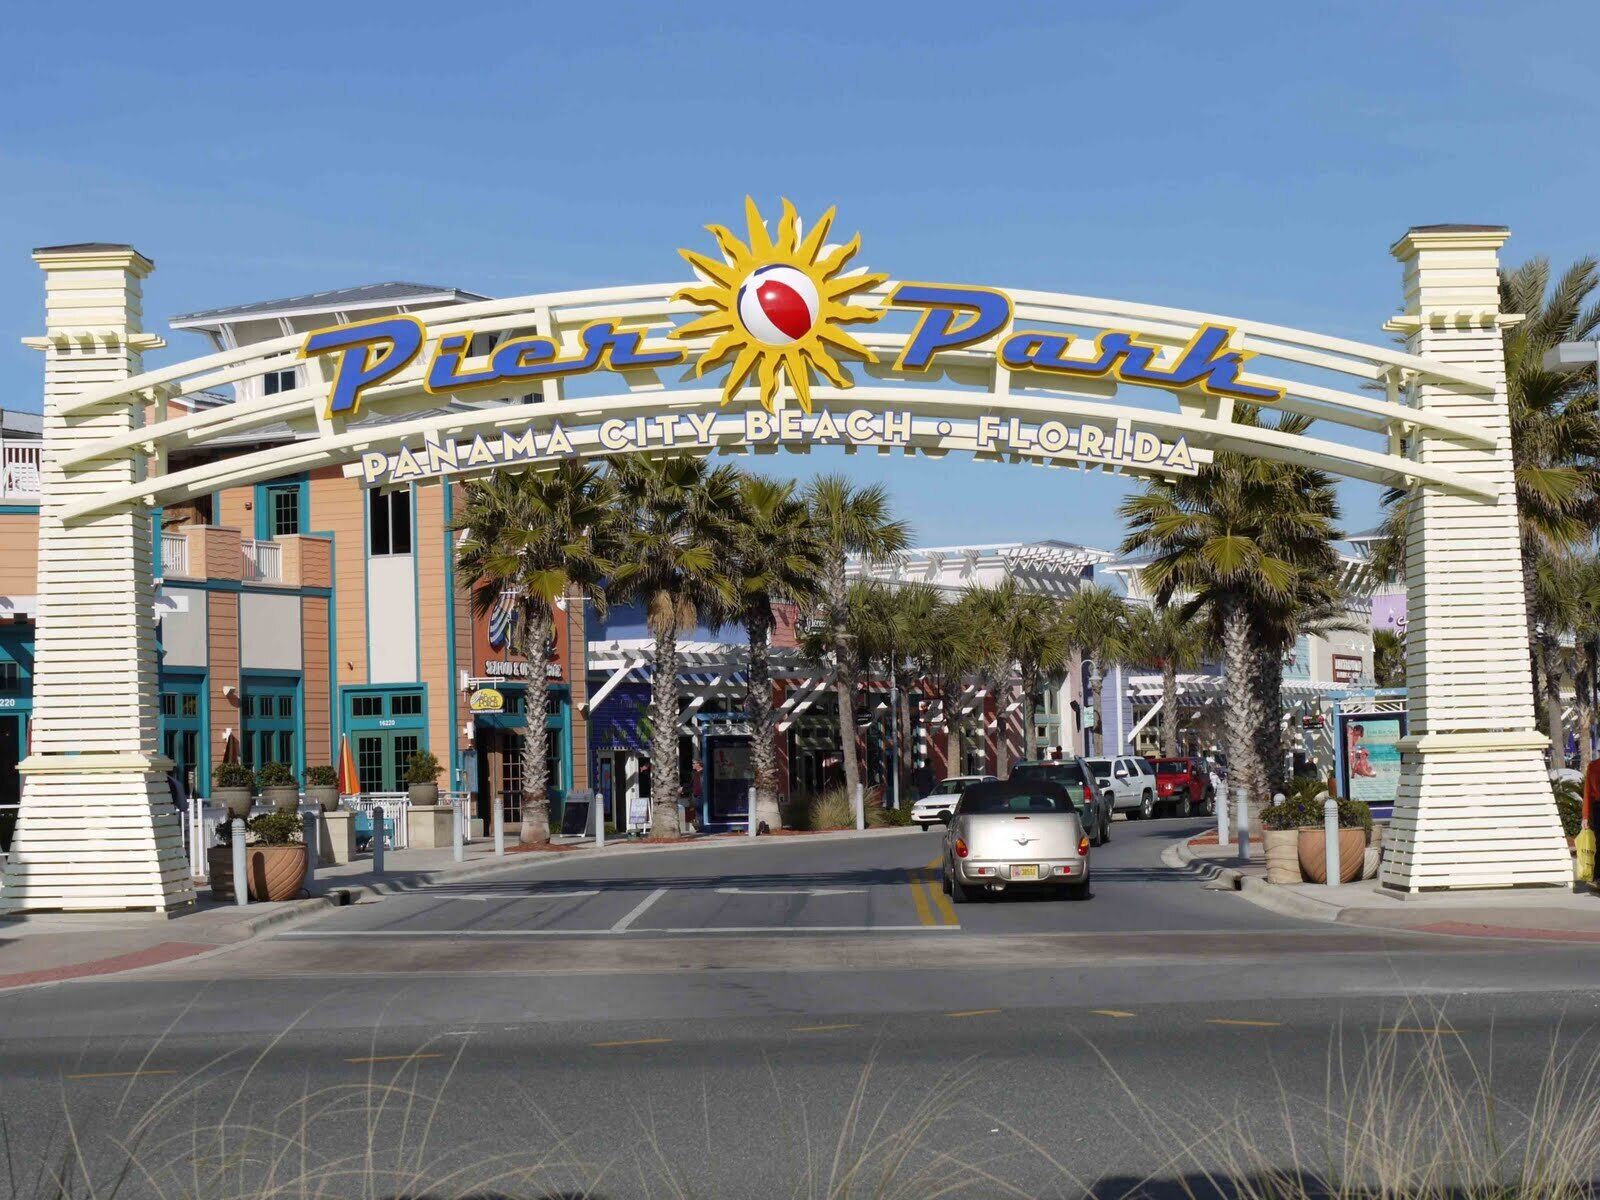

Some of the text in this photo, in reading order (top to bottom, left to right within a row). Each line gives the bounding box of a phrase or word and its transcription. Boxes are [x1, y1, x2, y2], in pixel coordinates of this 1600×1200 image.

[298, 281, 1287, 419] Pier Park
[362, 406, 1195, 483] PANAMA CITY BEACH FLORIDA
